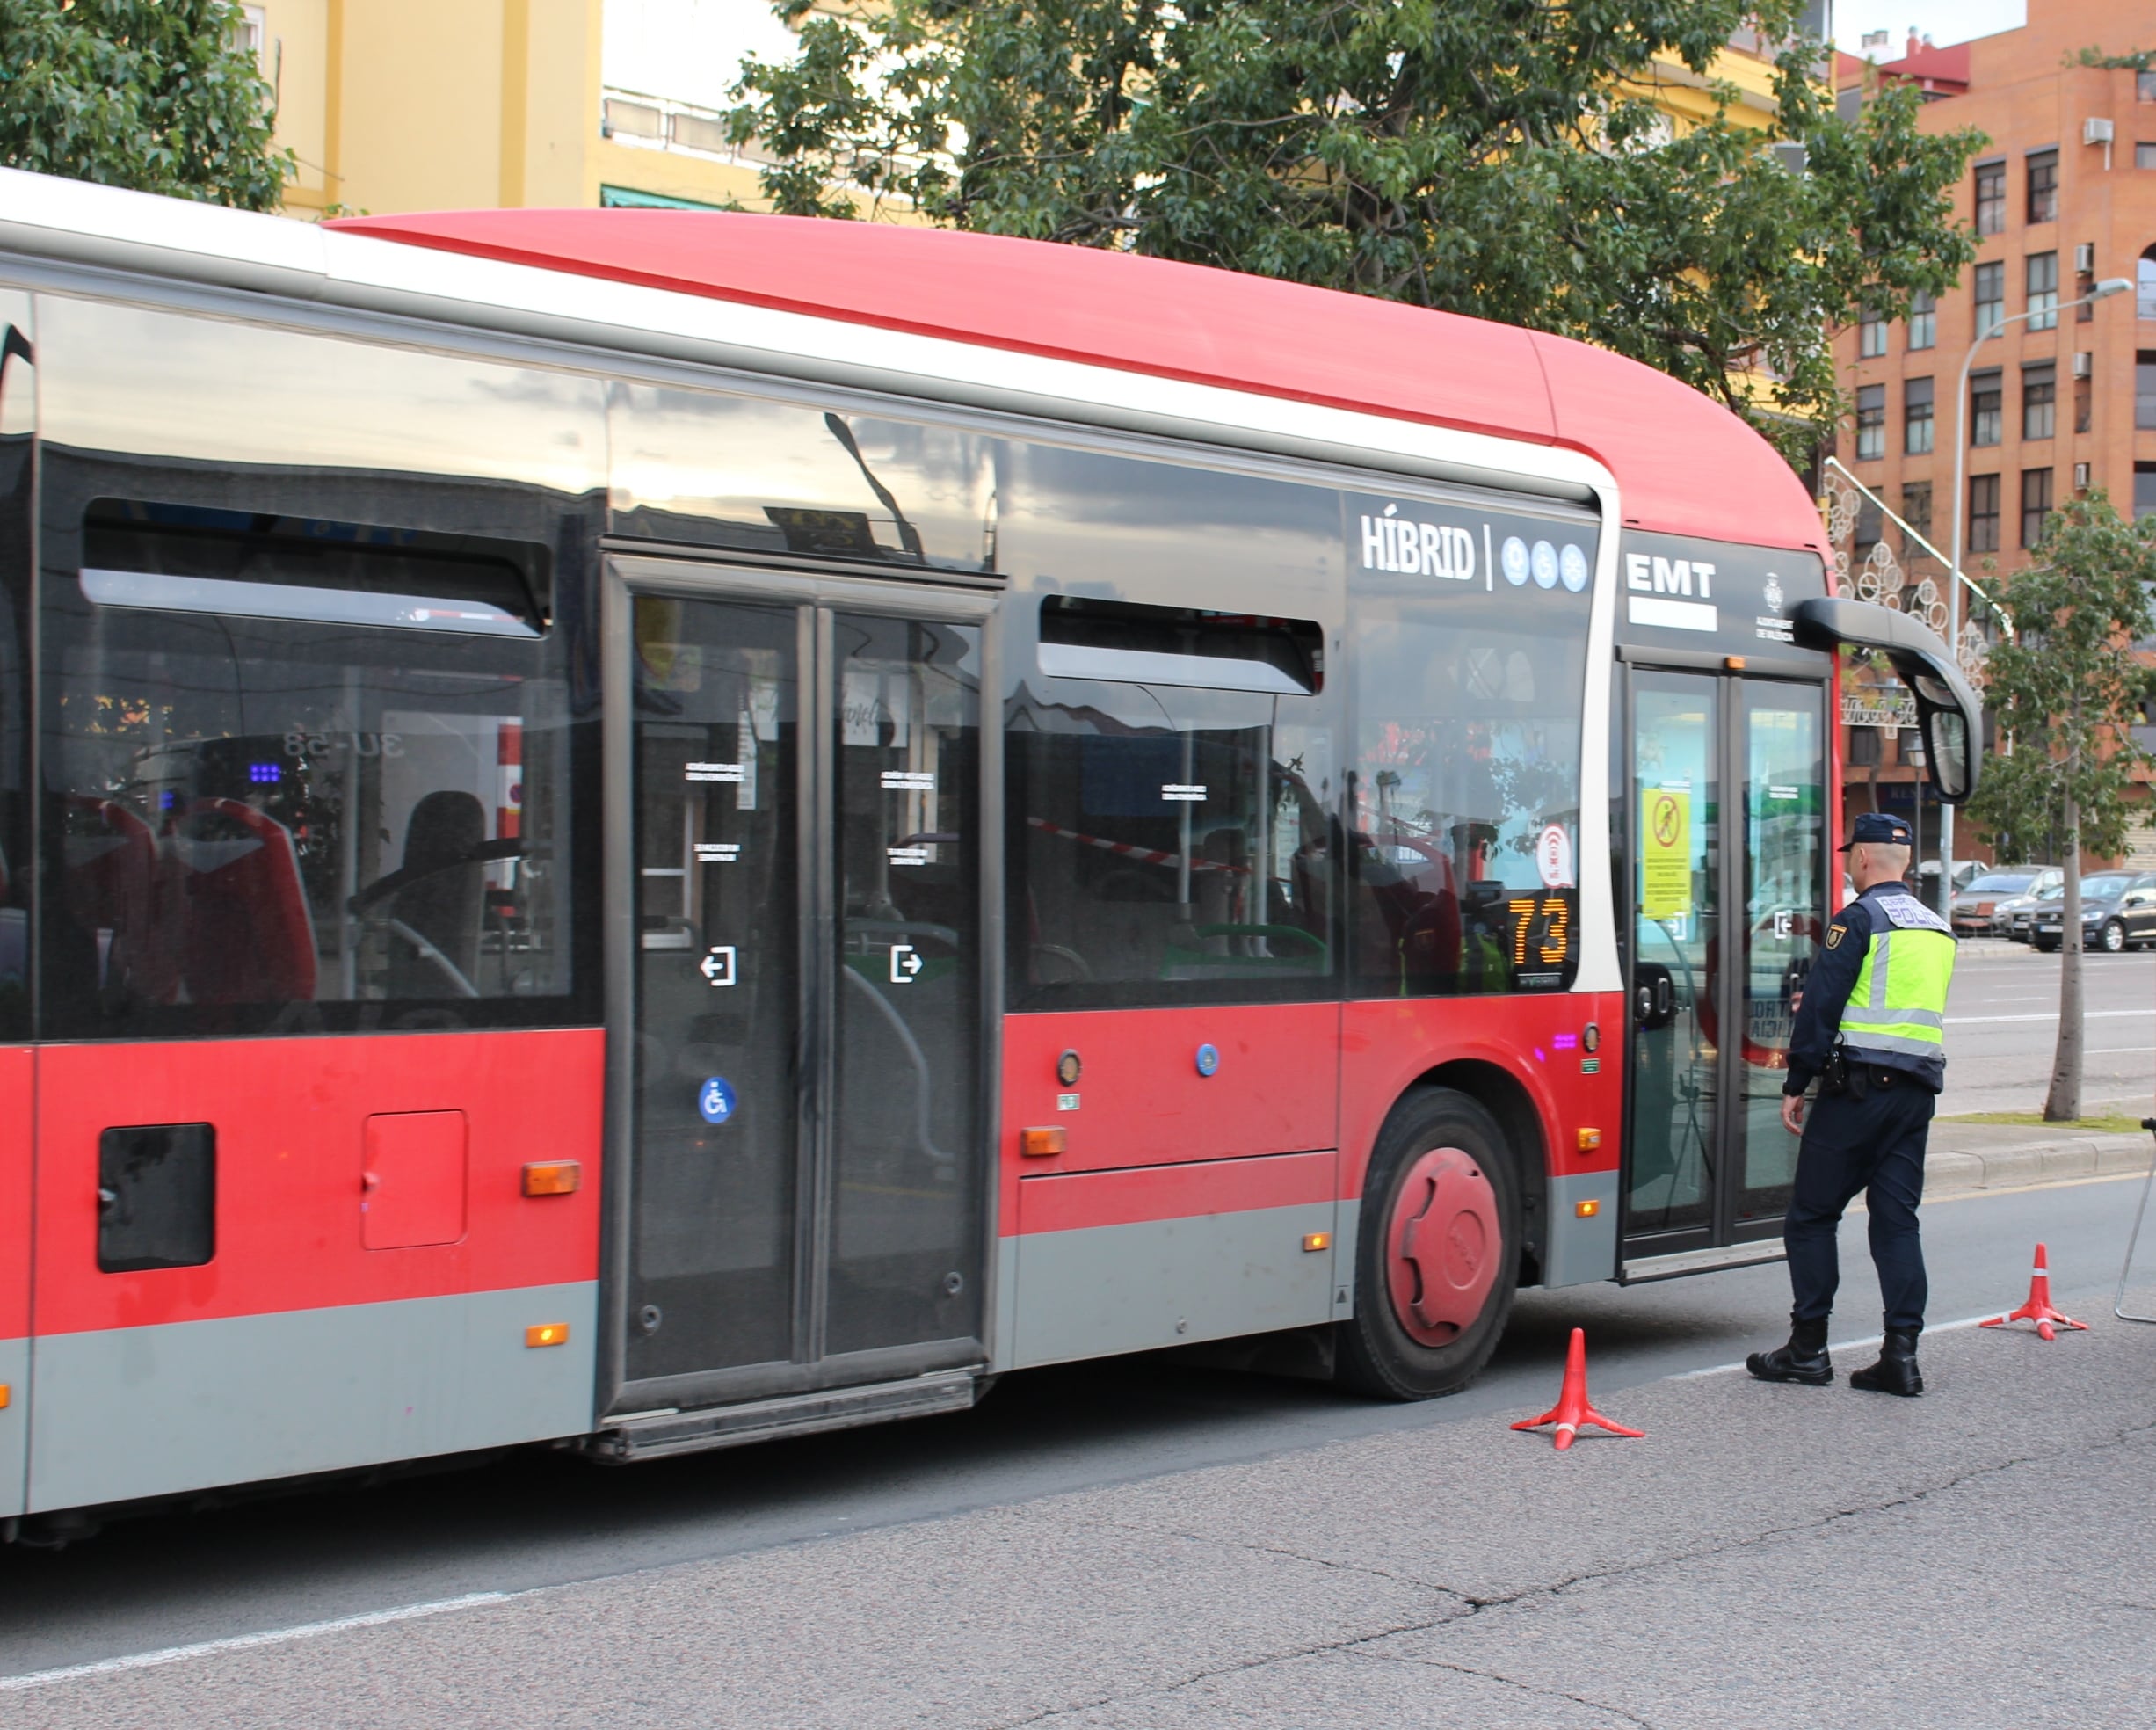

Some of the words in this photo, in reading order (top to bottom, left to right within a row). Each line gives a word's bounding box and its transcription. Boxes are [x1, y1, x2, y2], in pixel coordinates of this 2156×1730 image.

[1361, 503, 1476, 580] HÍBRID
[1626, 553, 1716, 598] EMT
[1508, 898, 1569, 964] 73
